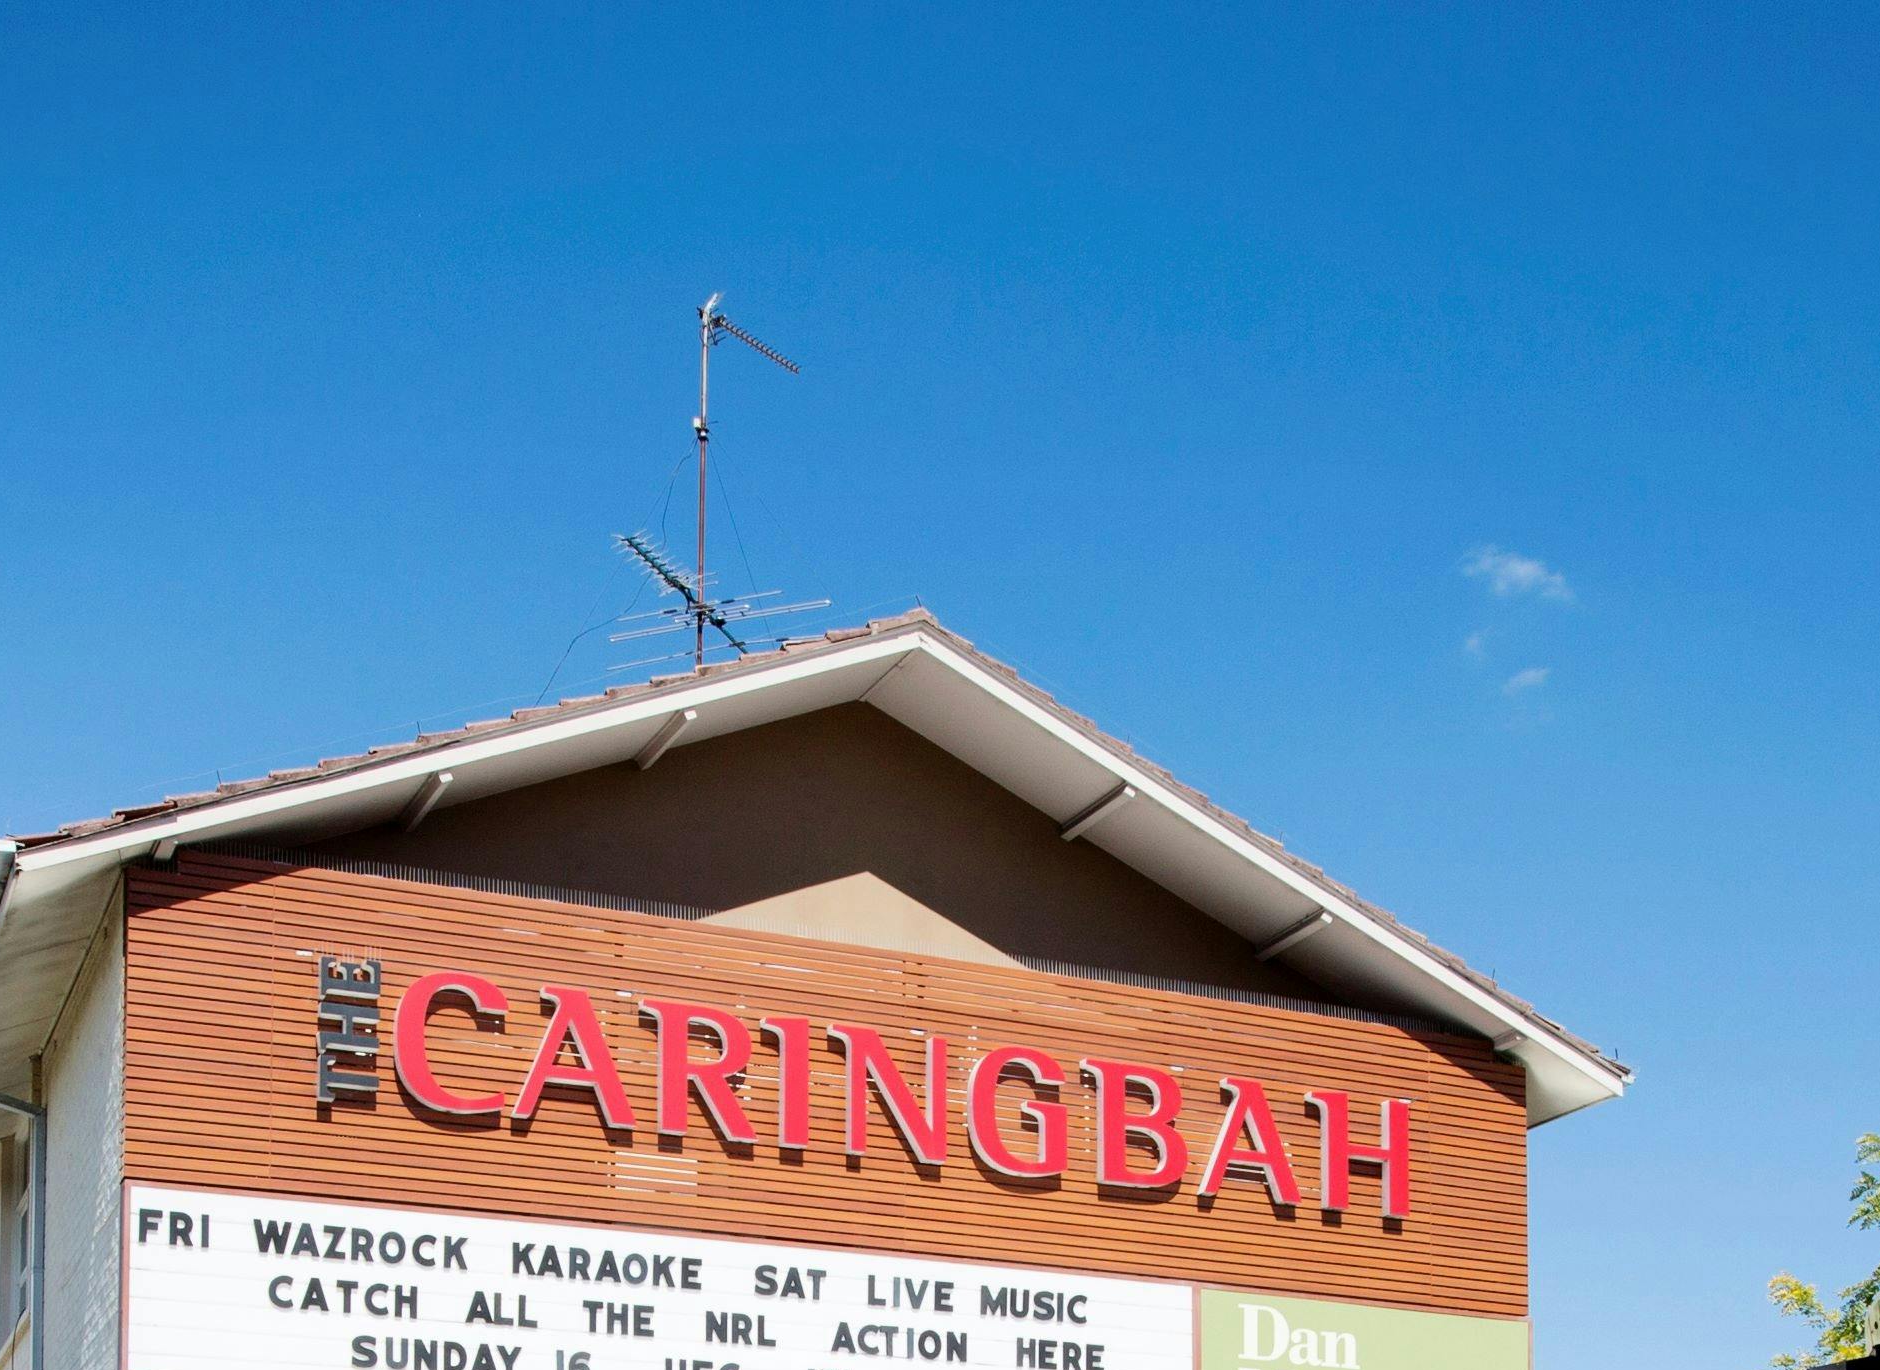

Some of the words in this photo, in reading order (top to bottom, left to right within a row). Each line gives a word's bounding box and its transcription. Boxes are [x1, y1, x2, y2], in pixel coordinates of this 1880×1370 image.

[317, 956, 382, 1103] THE
[393, 971, 1410, 1219] CARINGBAH
[138, 1208, 210, 1248] FRI
[253, 1218, 469, 1271] WAZROCK
[512, 1241, 703, 1291] KARAOKE
[754, 1264, 827, 1300] SAT
[867, 1274, 955, 1313] LIVE
[979, 1285, 1088, 1325] MUSIC
[268, 1275, 419, 1320] CATCH
[465, 1290, 538, 1329] ALL
[582, 1300, 655, 1338] THE
[705, 1310, 777, 1347] NRL
[831, 1321, 968, 1363] ACTION
[1238, 1303, 1361, 1370] Dan
